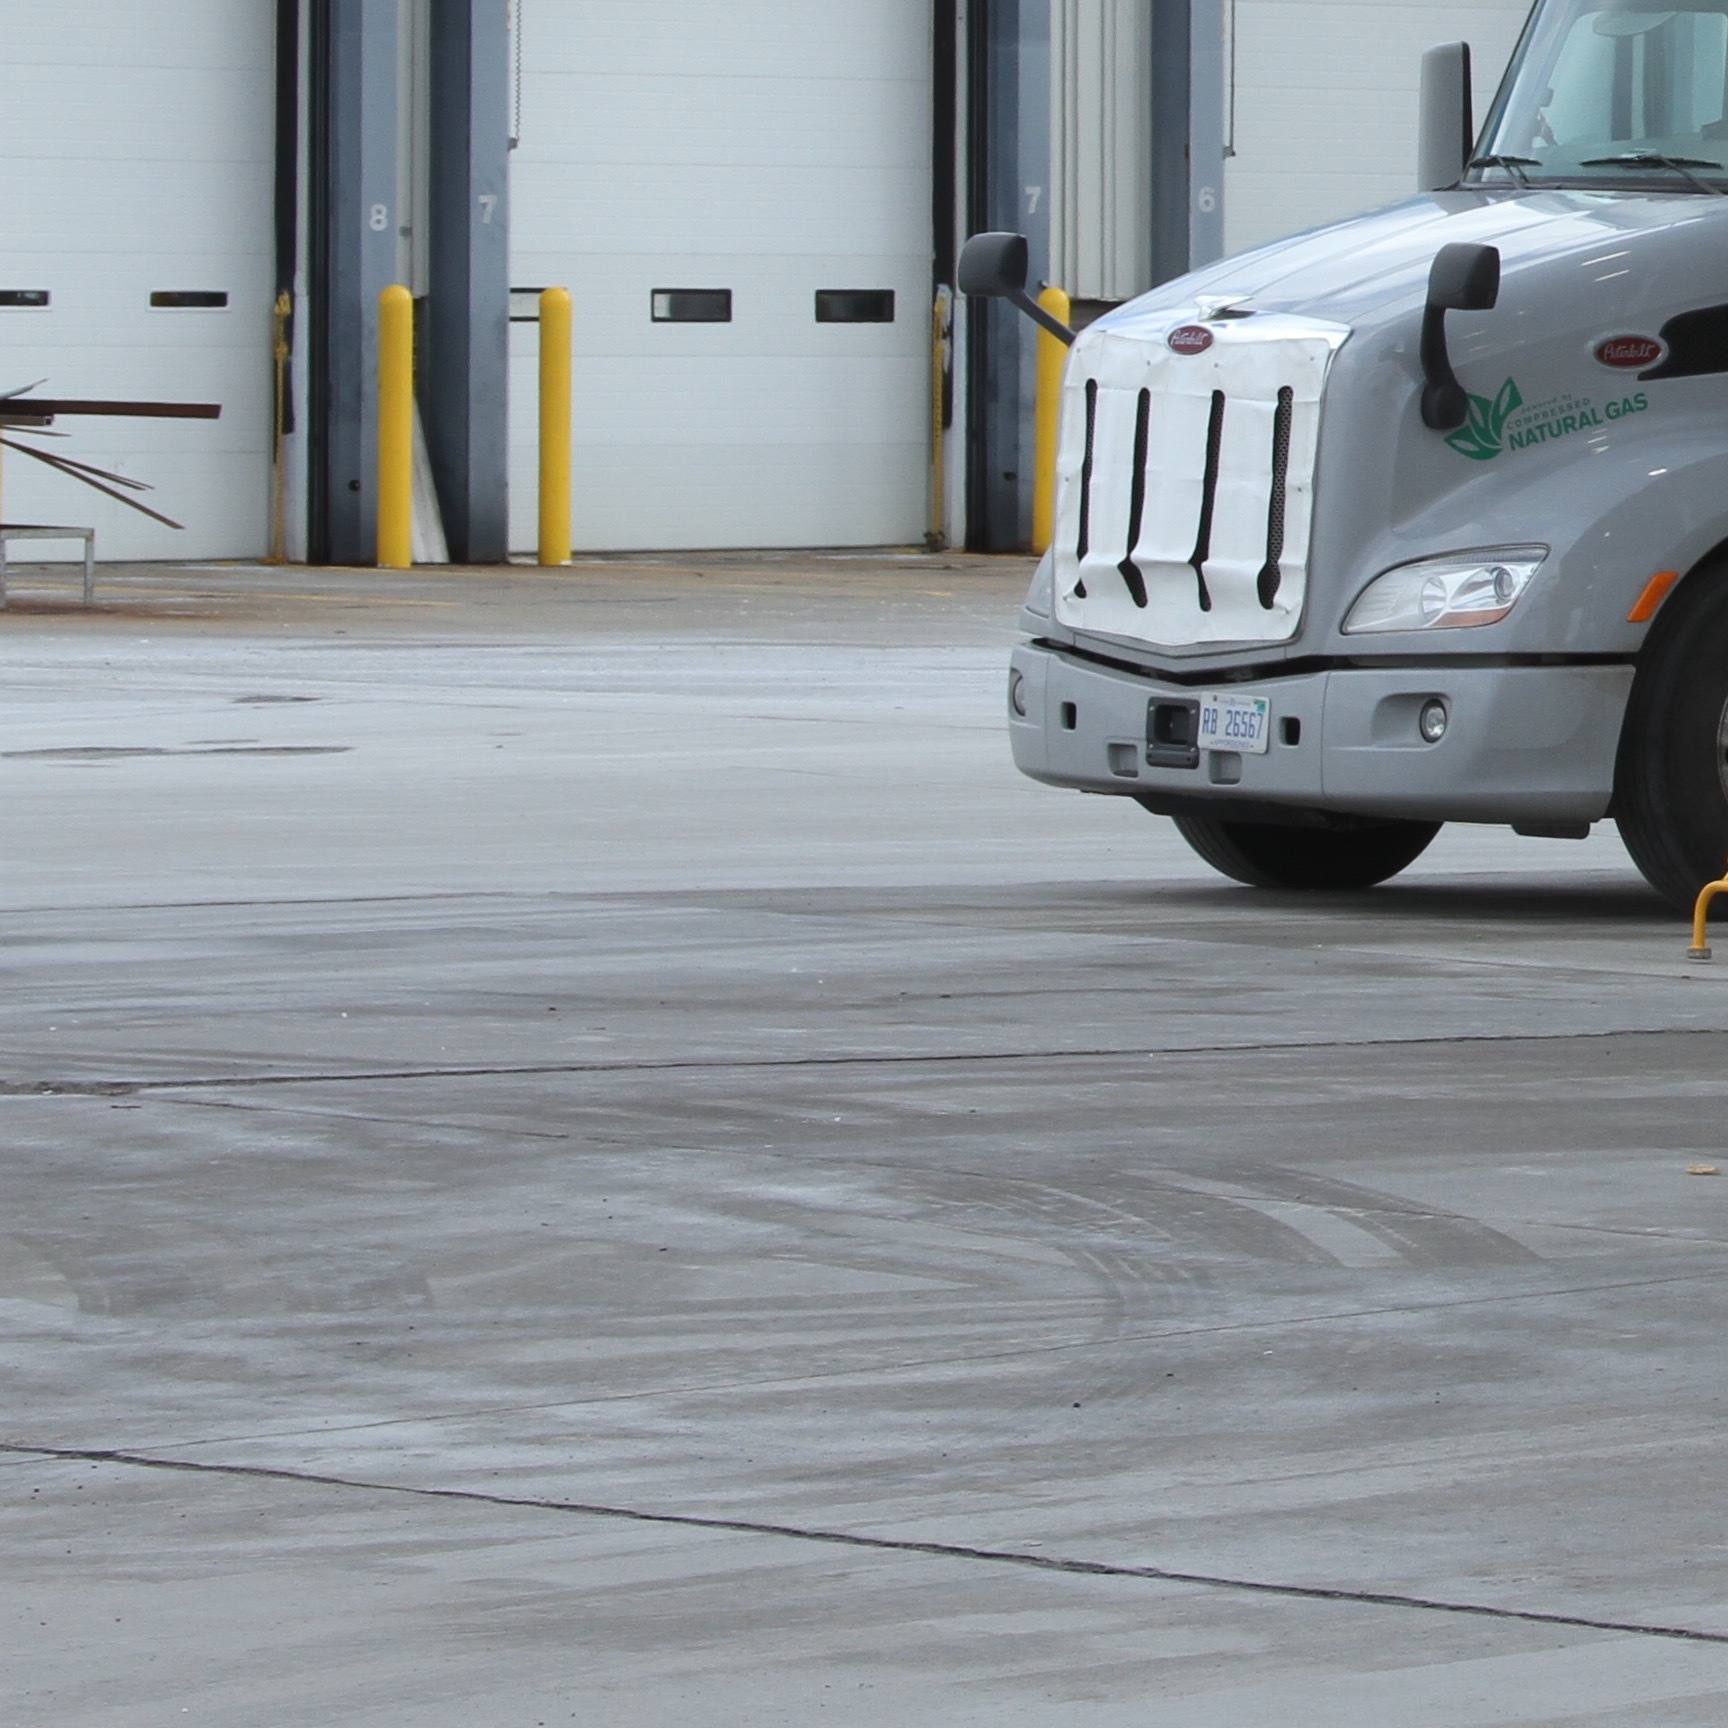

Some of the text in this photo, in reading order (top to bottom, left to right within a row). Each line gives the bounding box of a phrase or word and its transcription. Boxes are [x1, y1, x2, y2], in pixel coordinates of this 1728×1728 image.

[478, 194, 497, 224] 7
[1025, 186, 1041, 214] 7
[1199, 186, 1215, 213] 6
[369, 203, 388, 232] 8
[1603, 343, 1655, 361] Peterbilt
[1507, 398, 1590, 430] COMPRESSED
[1508, 392, 1648, 451] NATURAL GAS
[1202, 707, 1263, 739] RB 26567
